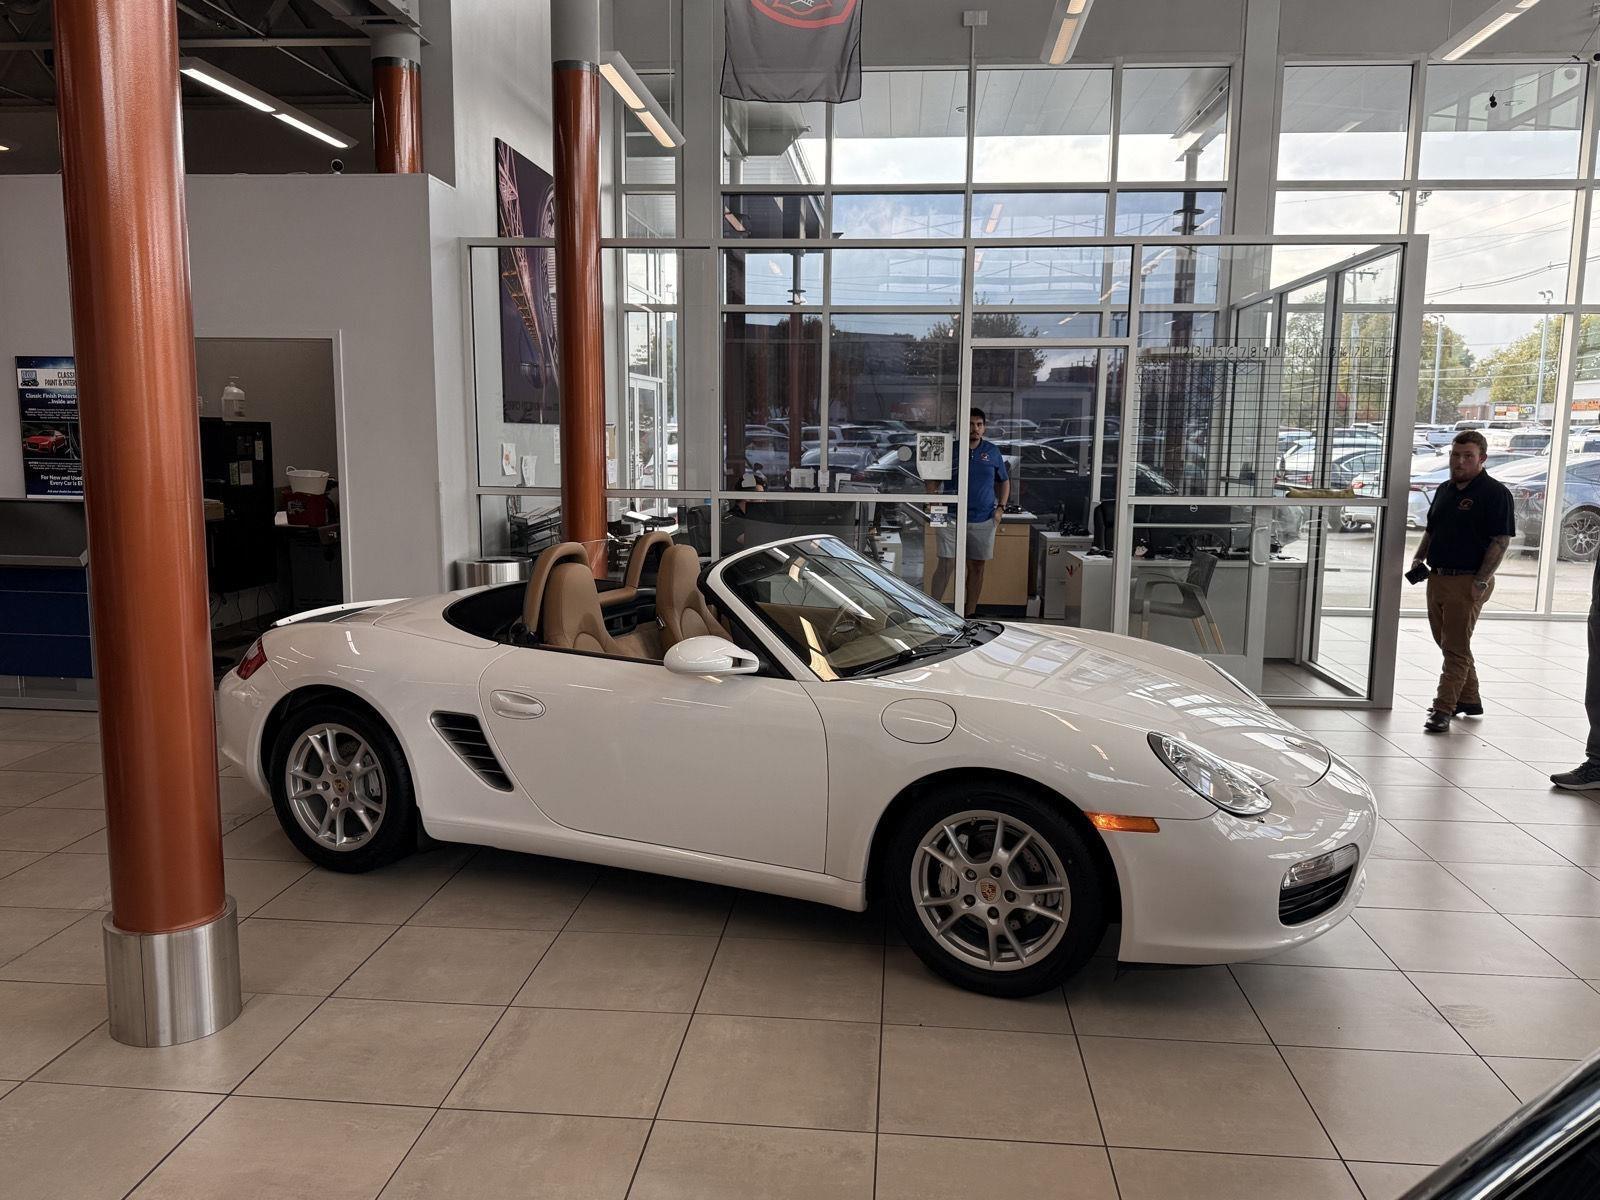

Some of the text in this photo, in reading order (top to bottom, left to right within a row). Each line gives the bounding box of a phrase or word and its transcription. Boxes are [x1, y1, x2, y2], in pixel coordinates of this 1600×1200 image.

[1193, 345, 1201, 357] 3
[1205, 345, 1211, 357] 4
[1227, 346, 1235, 357] 6
[1239, 346, 1246, 357] 7
[1250, 346, 1257, 358] 8
[1262, 346, 1269, 357] 9
[1272, 346, 1281, 357] 10
[1374, 346, 1382, 357] 19
